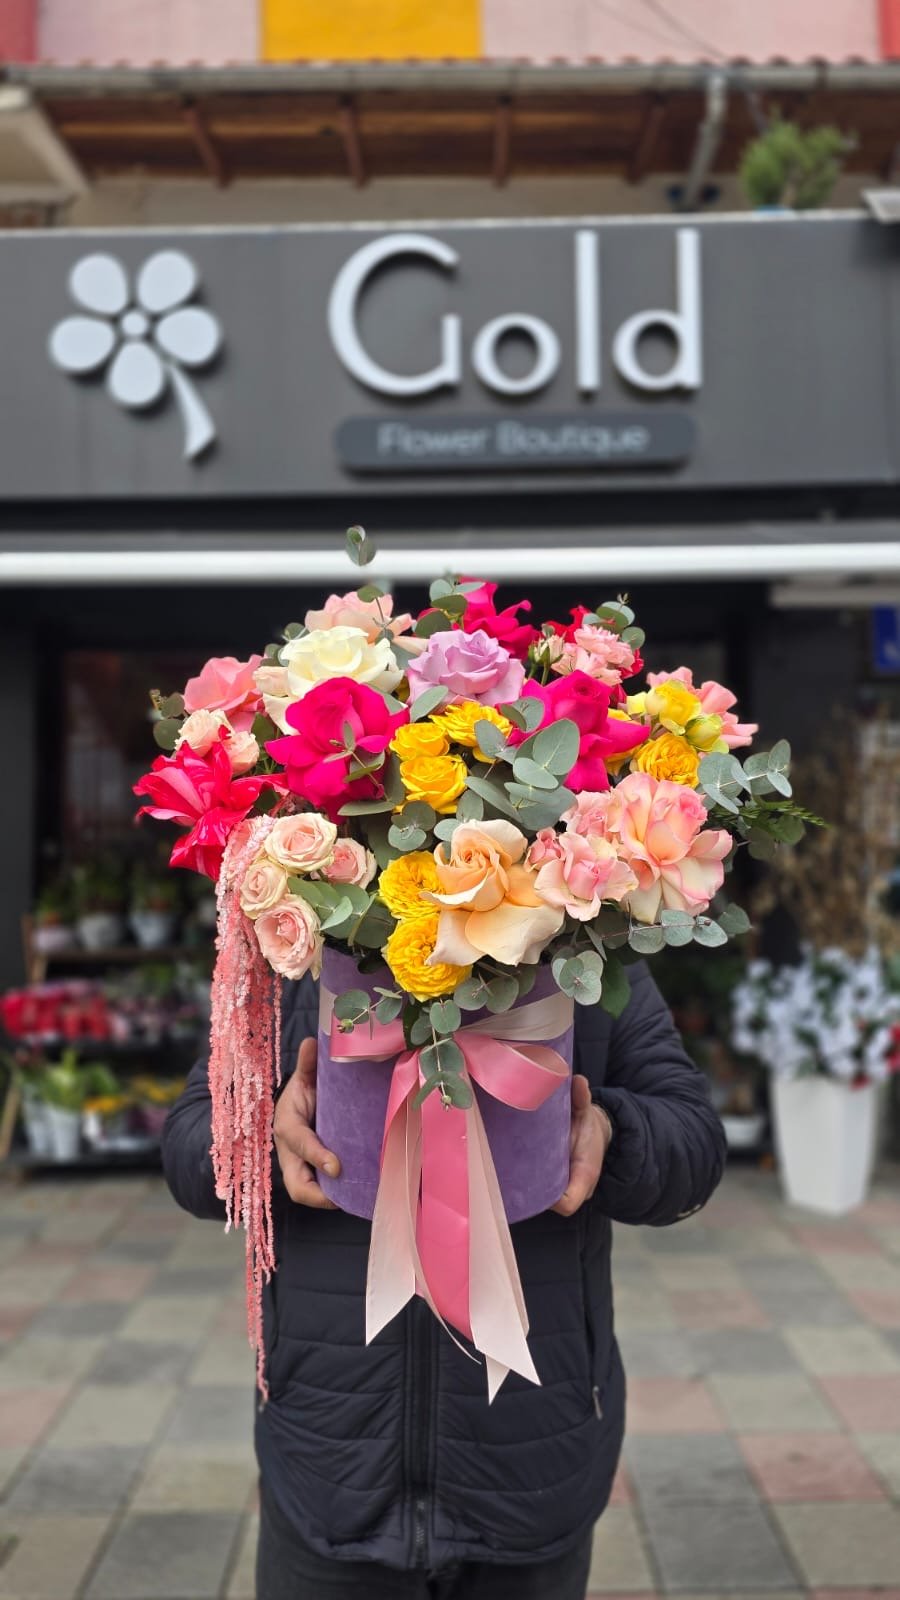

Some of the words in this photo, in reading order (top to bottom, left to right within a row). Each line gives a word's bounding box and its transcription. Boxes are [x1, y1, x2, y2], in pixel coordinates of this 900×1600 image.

[328, 228, 702, 395] Gold
[377, 423, 487, 455] Flower
[498, 420, 650, 457] Boutique
